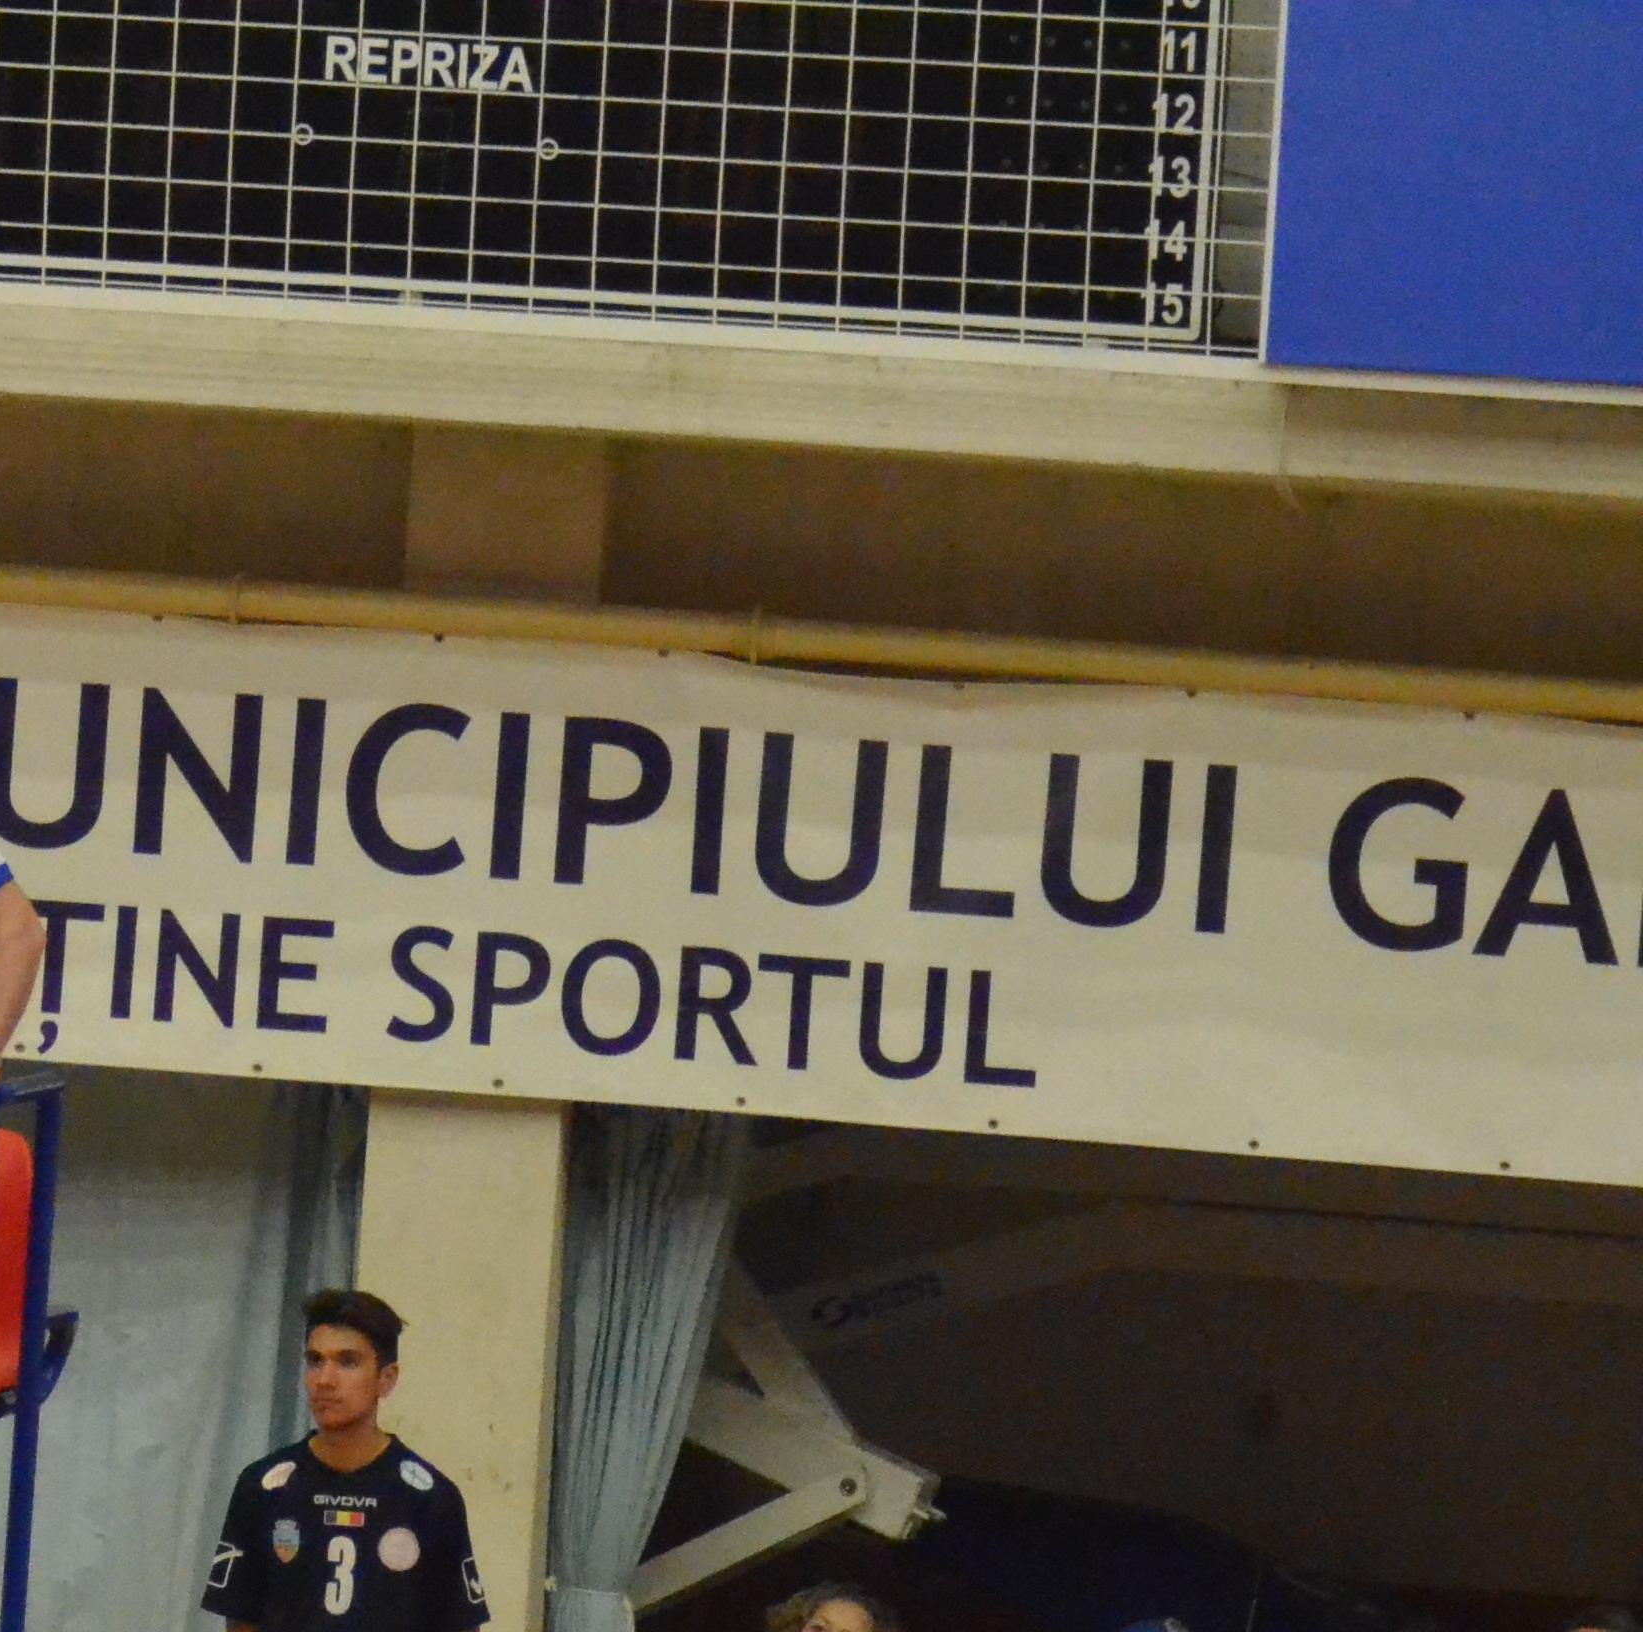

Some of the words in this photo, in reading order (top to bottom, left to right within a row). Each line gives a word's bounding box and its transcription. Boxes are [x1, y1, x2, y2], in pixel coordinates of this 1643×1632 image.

[324, 35, 534, 93] REPRIZA
[1161, 30, 1197, 73] 11
[1152, 92, 1196, 135] 12
[1148, 156, 1192, 199] 13
[1144, 219, 1188, 262] 14
[1140, 282, 1184, 325] 15
[1328, 776, 1643, 968] GA
[387, 924, 1037, 1089] SPORTUL
[313, 1494, 378, 1508] GIVOVA
[323, 1535, 357, 1616] 3
